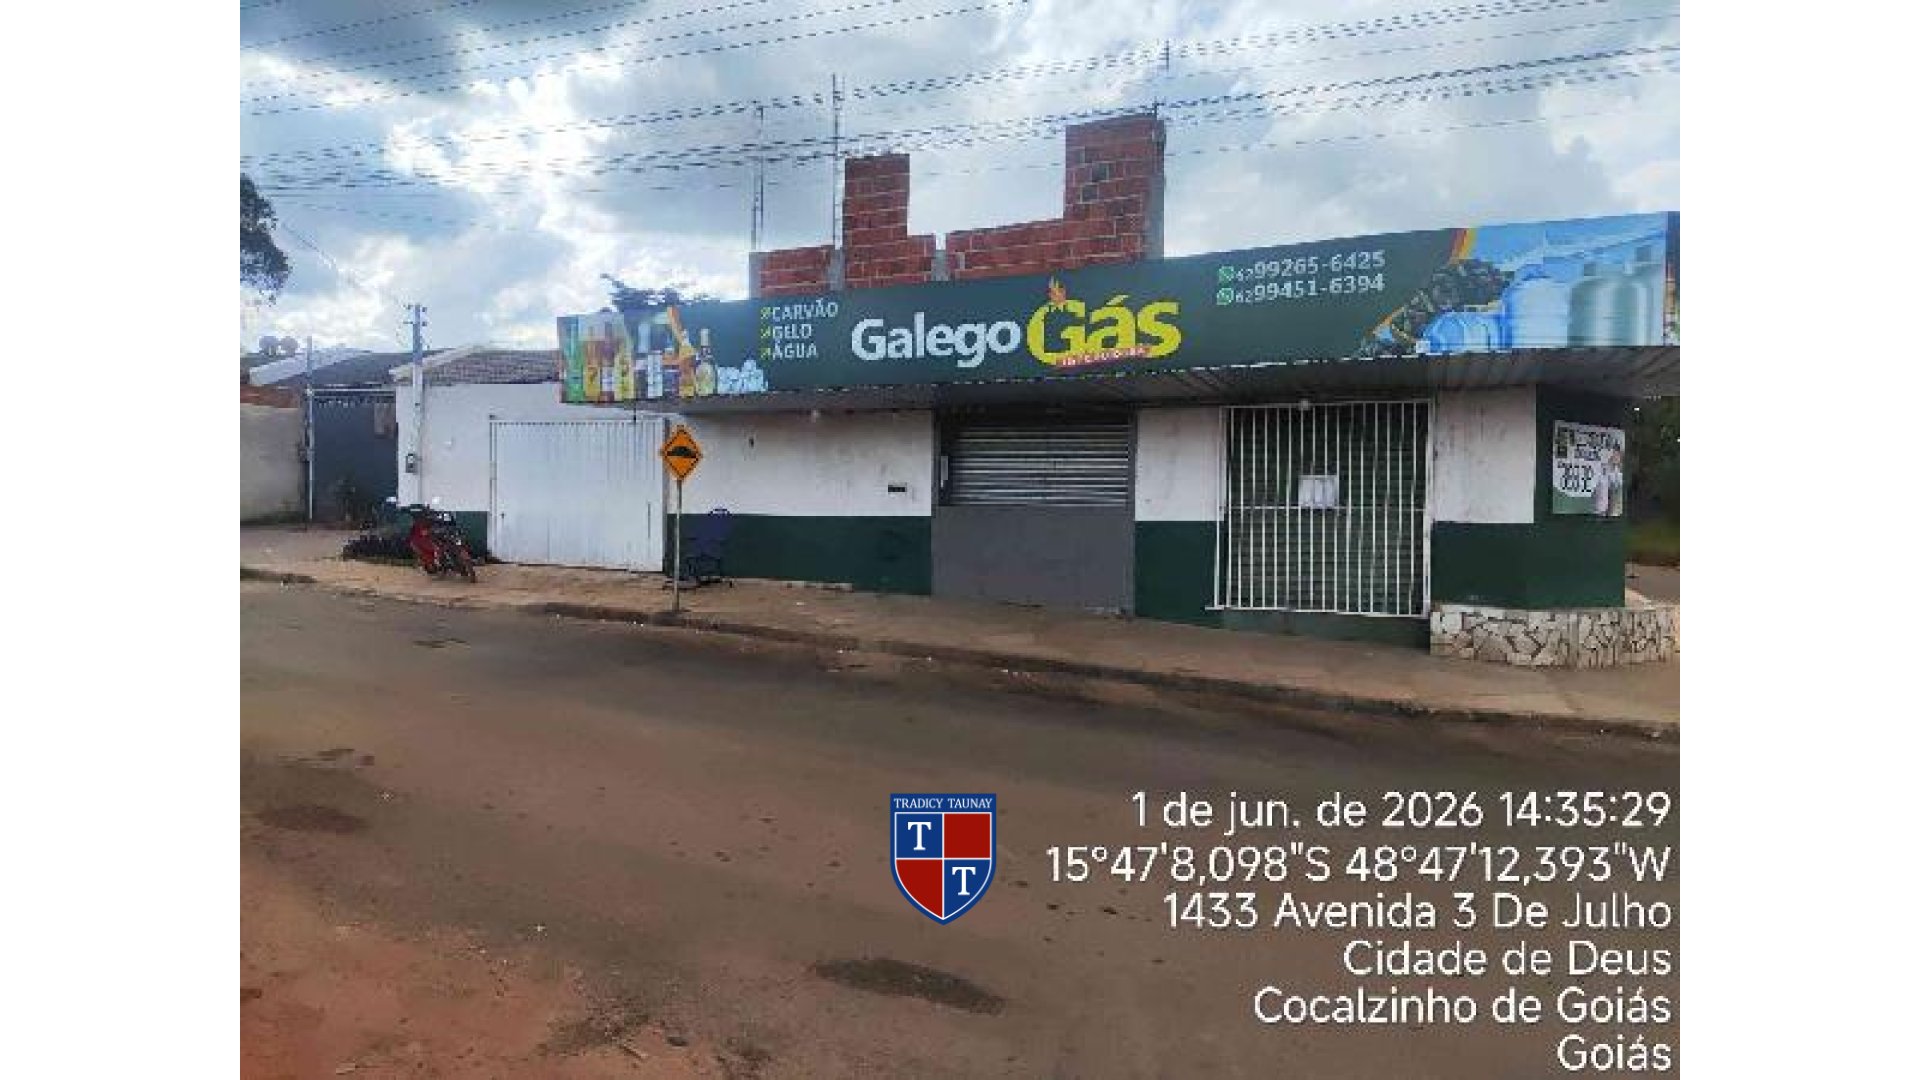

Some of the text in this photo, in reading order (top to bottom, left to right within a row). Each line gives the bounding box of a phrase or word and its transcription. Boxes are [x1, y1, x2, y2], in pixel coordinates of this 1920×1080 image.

[772, 298, 839, 322] CARVÃO
[772, 323, 812, 339] GELO
[851, 294, 1182, 368] Galego Gás
